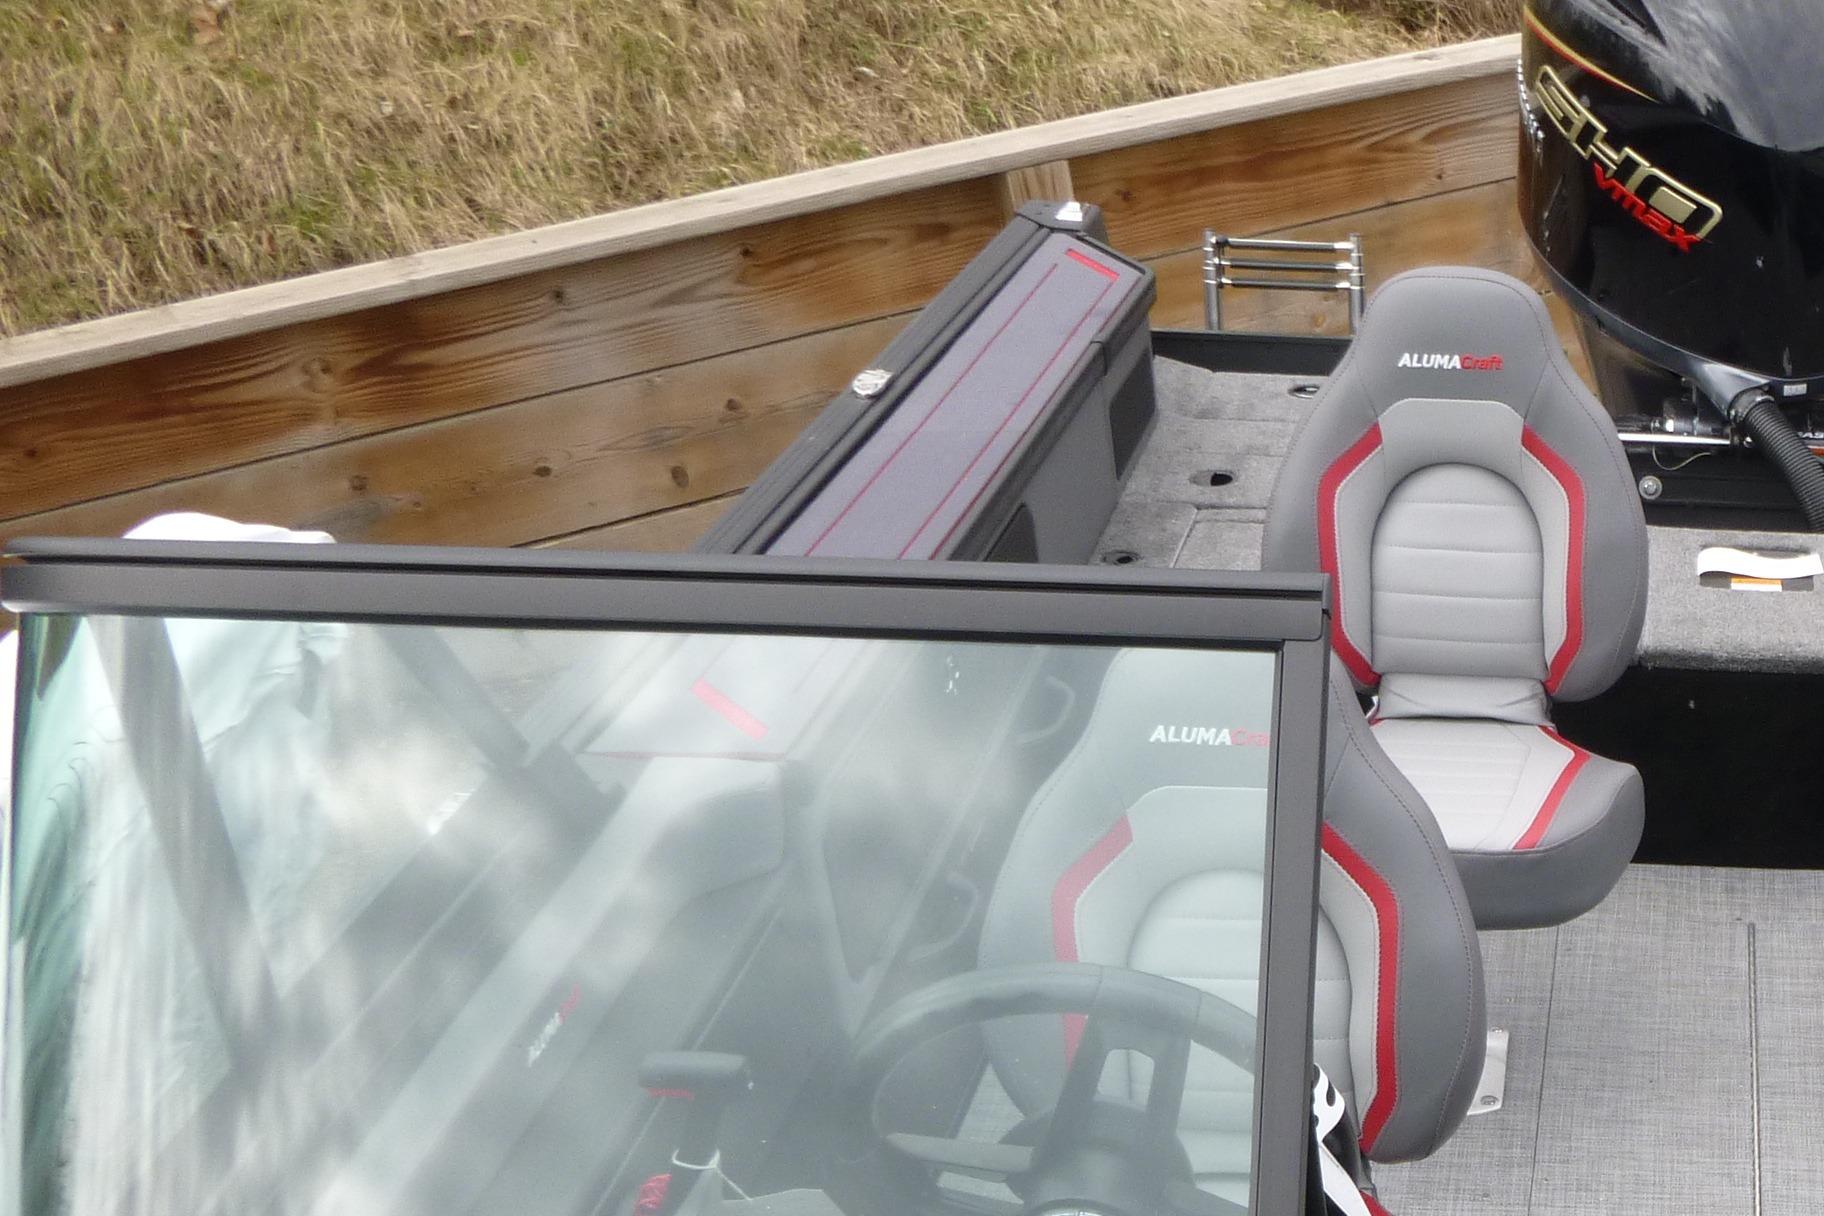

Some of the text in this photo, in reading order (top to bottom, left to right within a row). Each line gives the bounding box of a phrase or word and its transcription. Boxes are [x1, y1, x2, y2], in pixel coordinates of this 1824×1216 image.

[1535, 64, 1723, 241] SHO
[1397, 352, 1504, 371] ALUMACraft
[1149, 725, 1270, 748] ALUMACra
